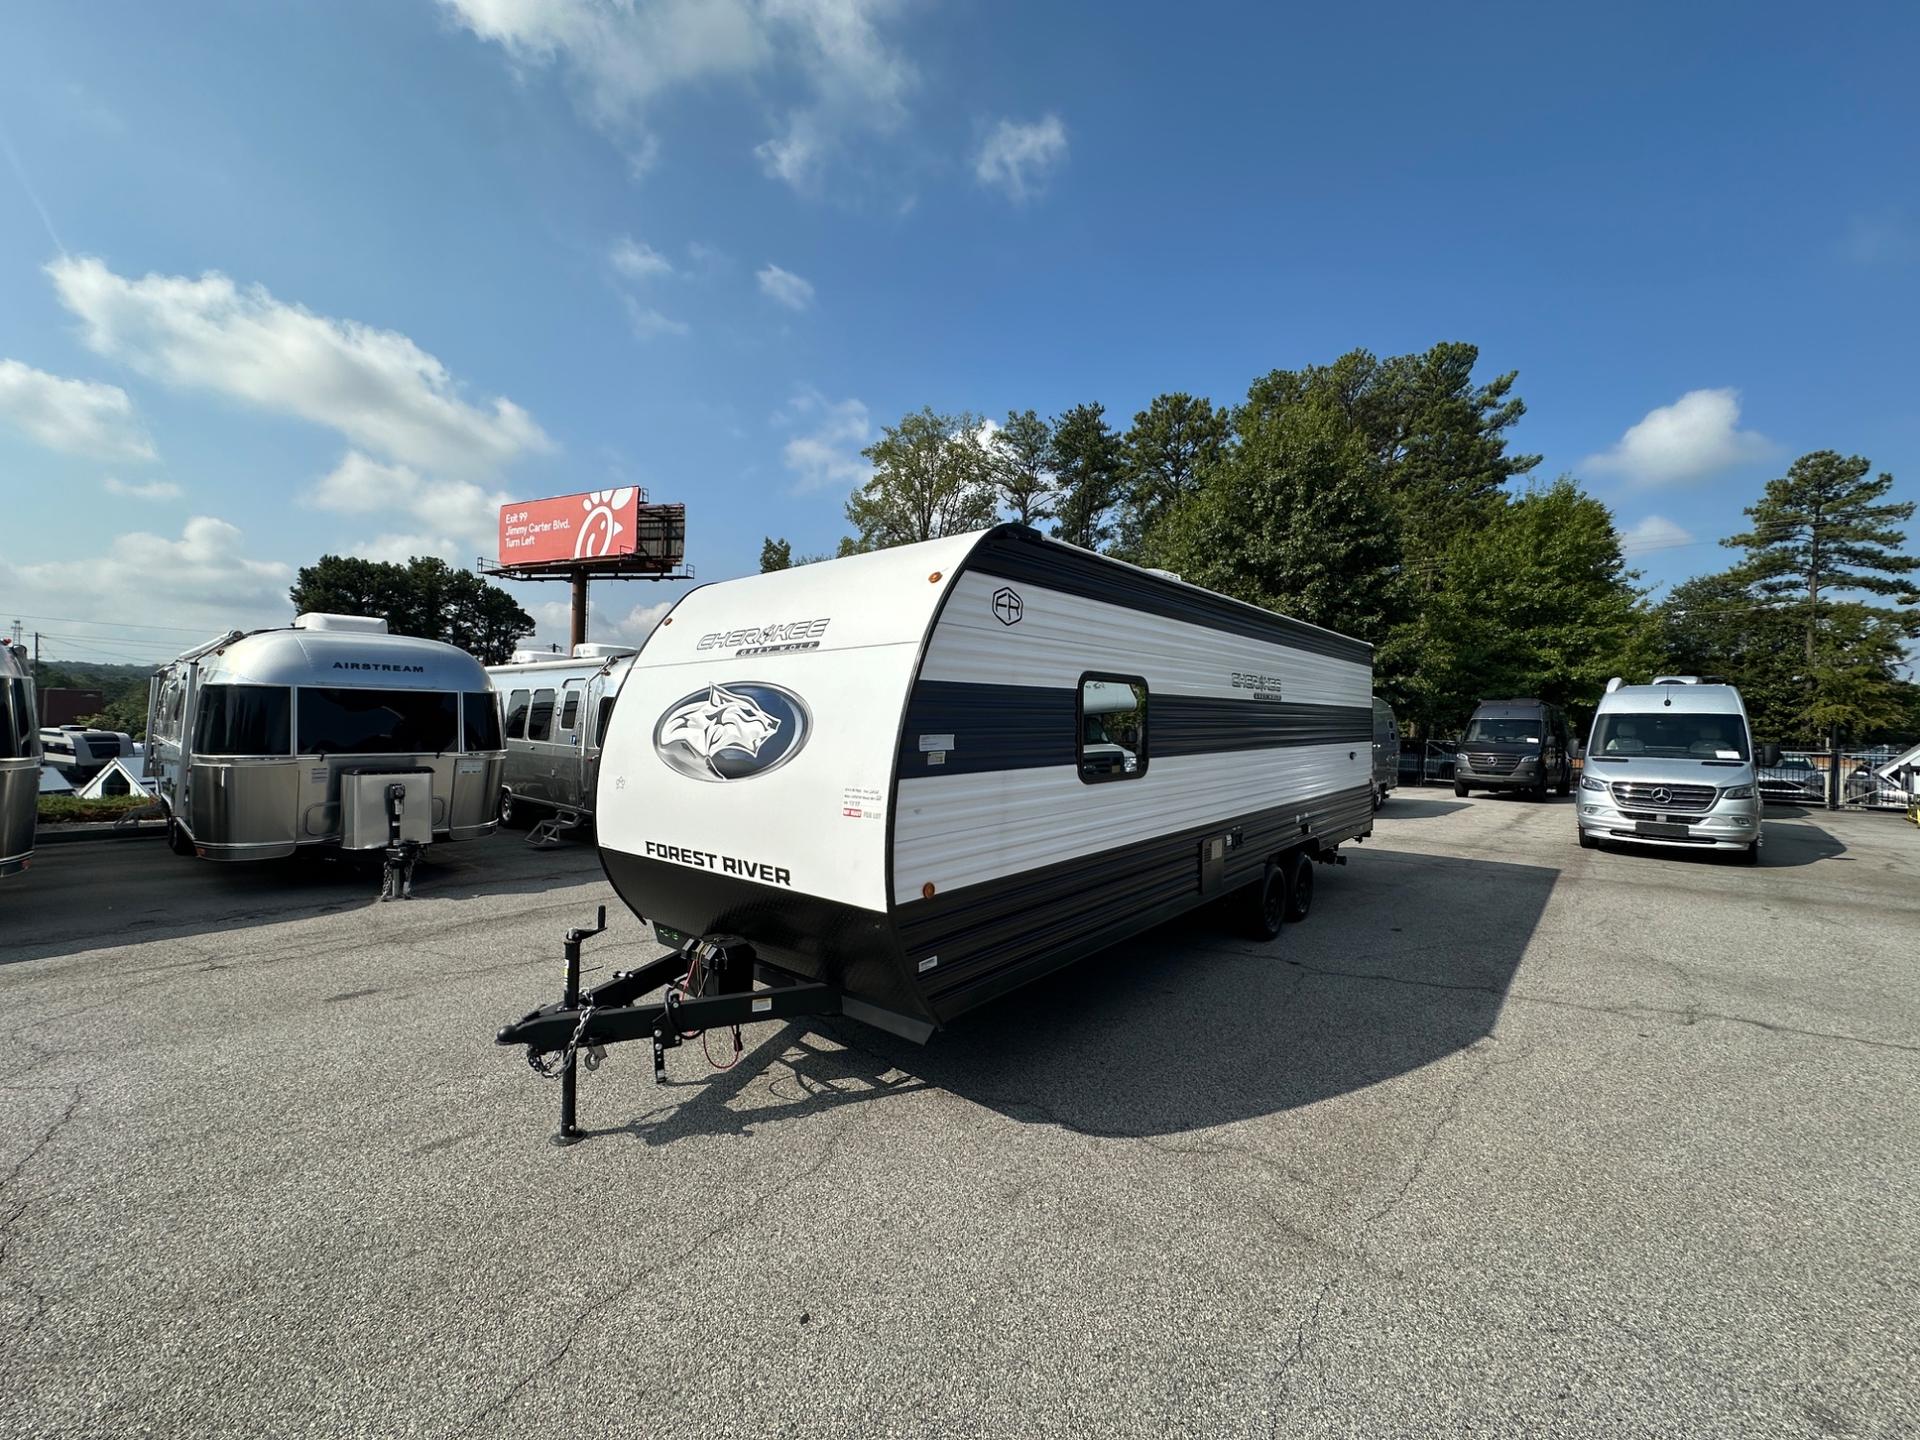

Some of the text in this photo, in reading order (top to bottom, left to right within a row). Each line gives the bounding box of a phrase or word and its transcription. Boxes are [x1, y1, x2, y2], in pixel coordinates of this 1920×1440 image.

[505, 512, 528, 524] Exit 99
[505, 518, 571, 536] Jimmy Carter Blvd.
[505, 535, 535, 548] Turn Left
[741, 642, 815, 656] GREY WOLF
[332, 661, 424, 673] AIRSTREAM
[645, 840, 791, 886] FOREST RIVER
